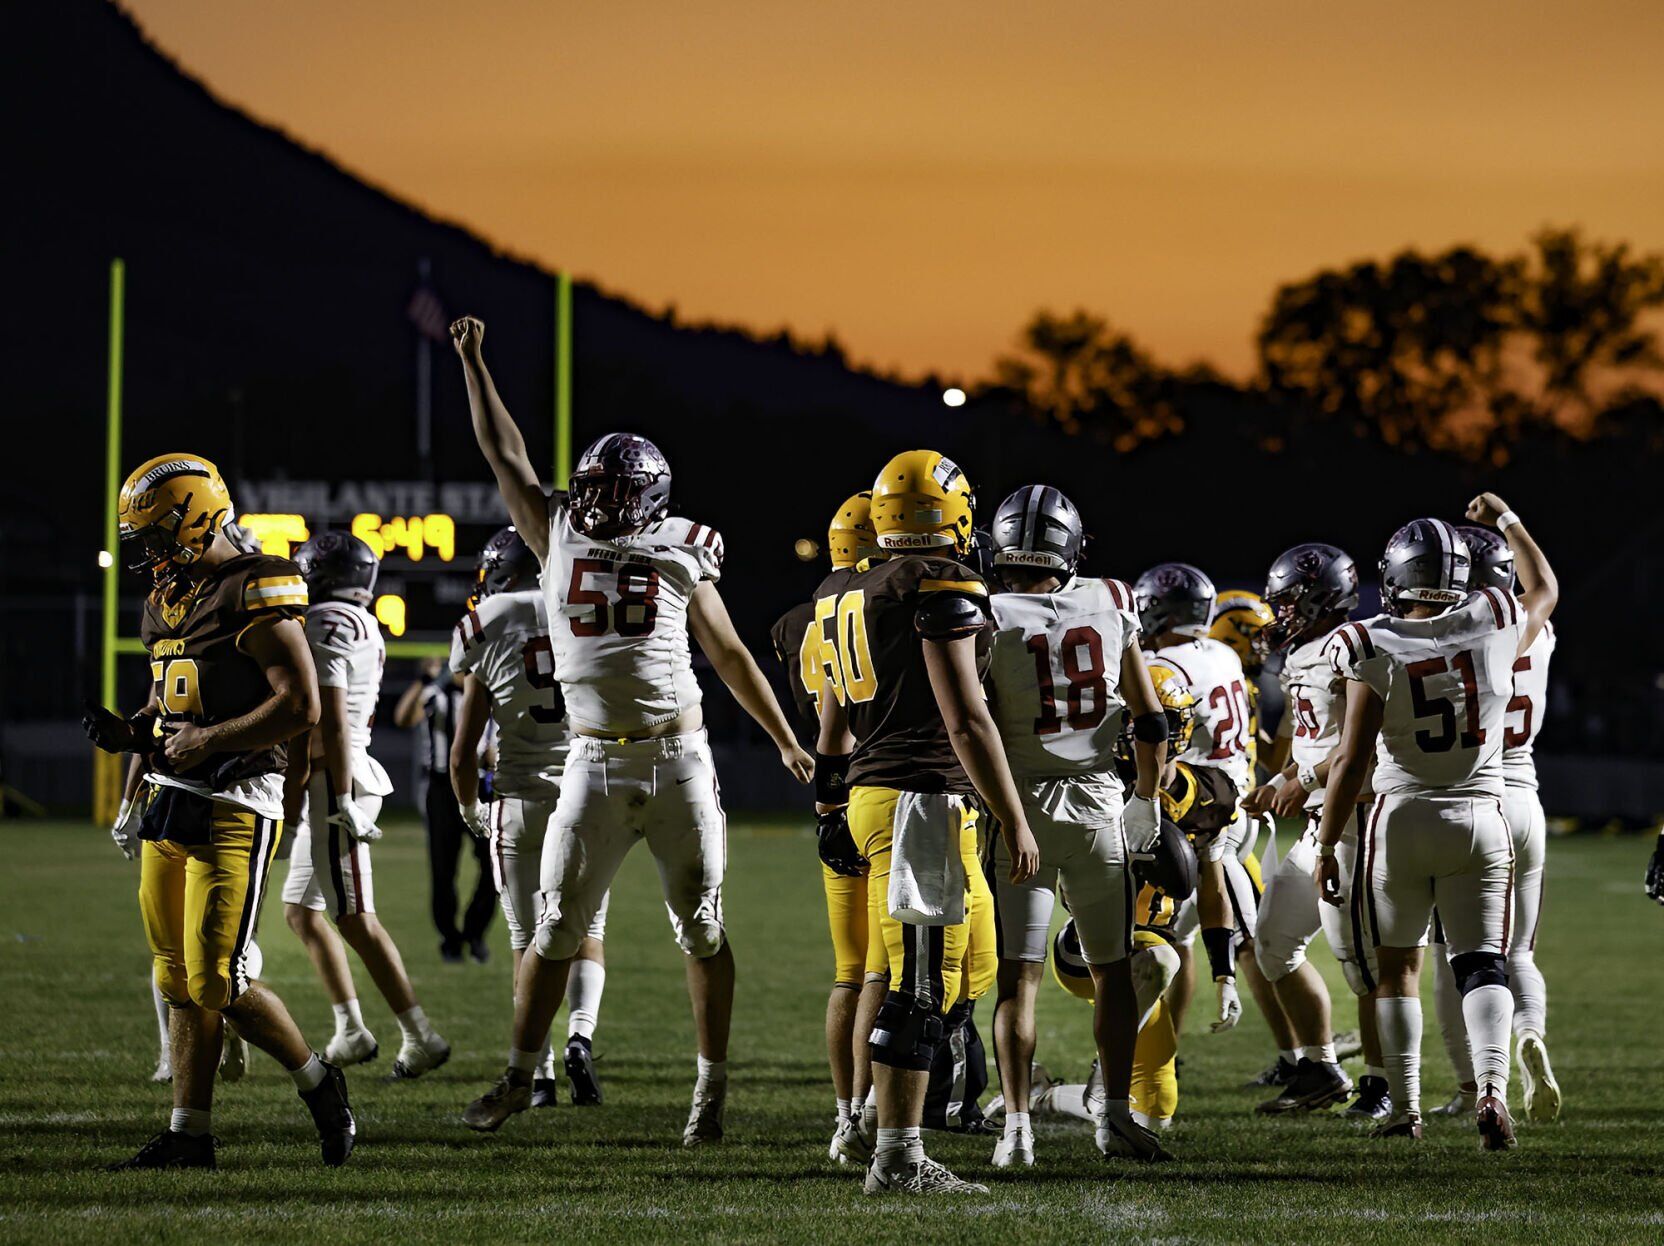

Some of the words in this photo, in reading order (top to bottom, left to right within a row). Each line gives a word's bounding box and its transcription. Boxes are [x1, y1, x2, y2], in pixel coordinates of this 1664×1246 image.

[145, 461, 191, 483] BRUINS
[884, 537, 931, 548] Riddell
[1005, 553, 1051, 565] Riddell
[567, 558, 660, 637] 58
[815, 589, 878, 707] 50
[1026, 625, 1107, 735] 18
[1405, 650, 1487, 753] 51
